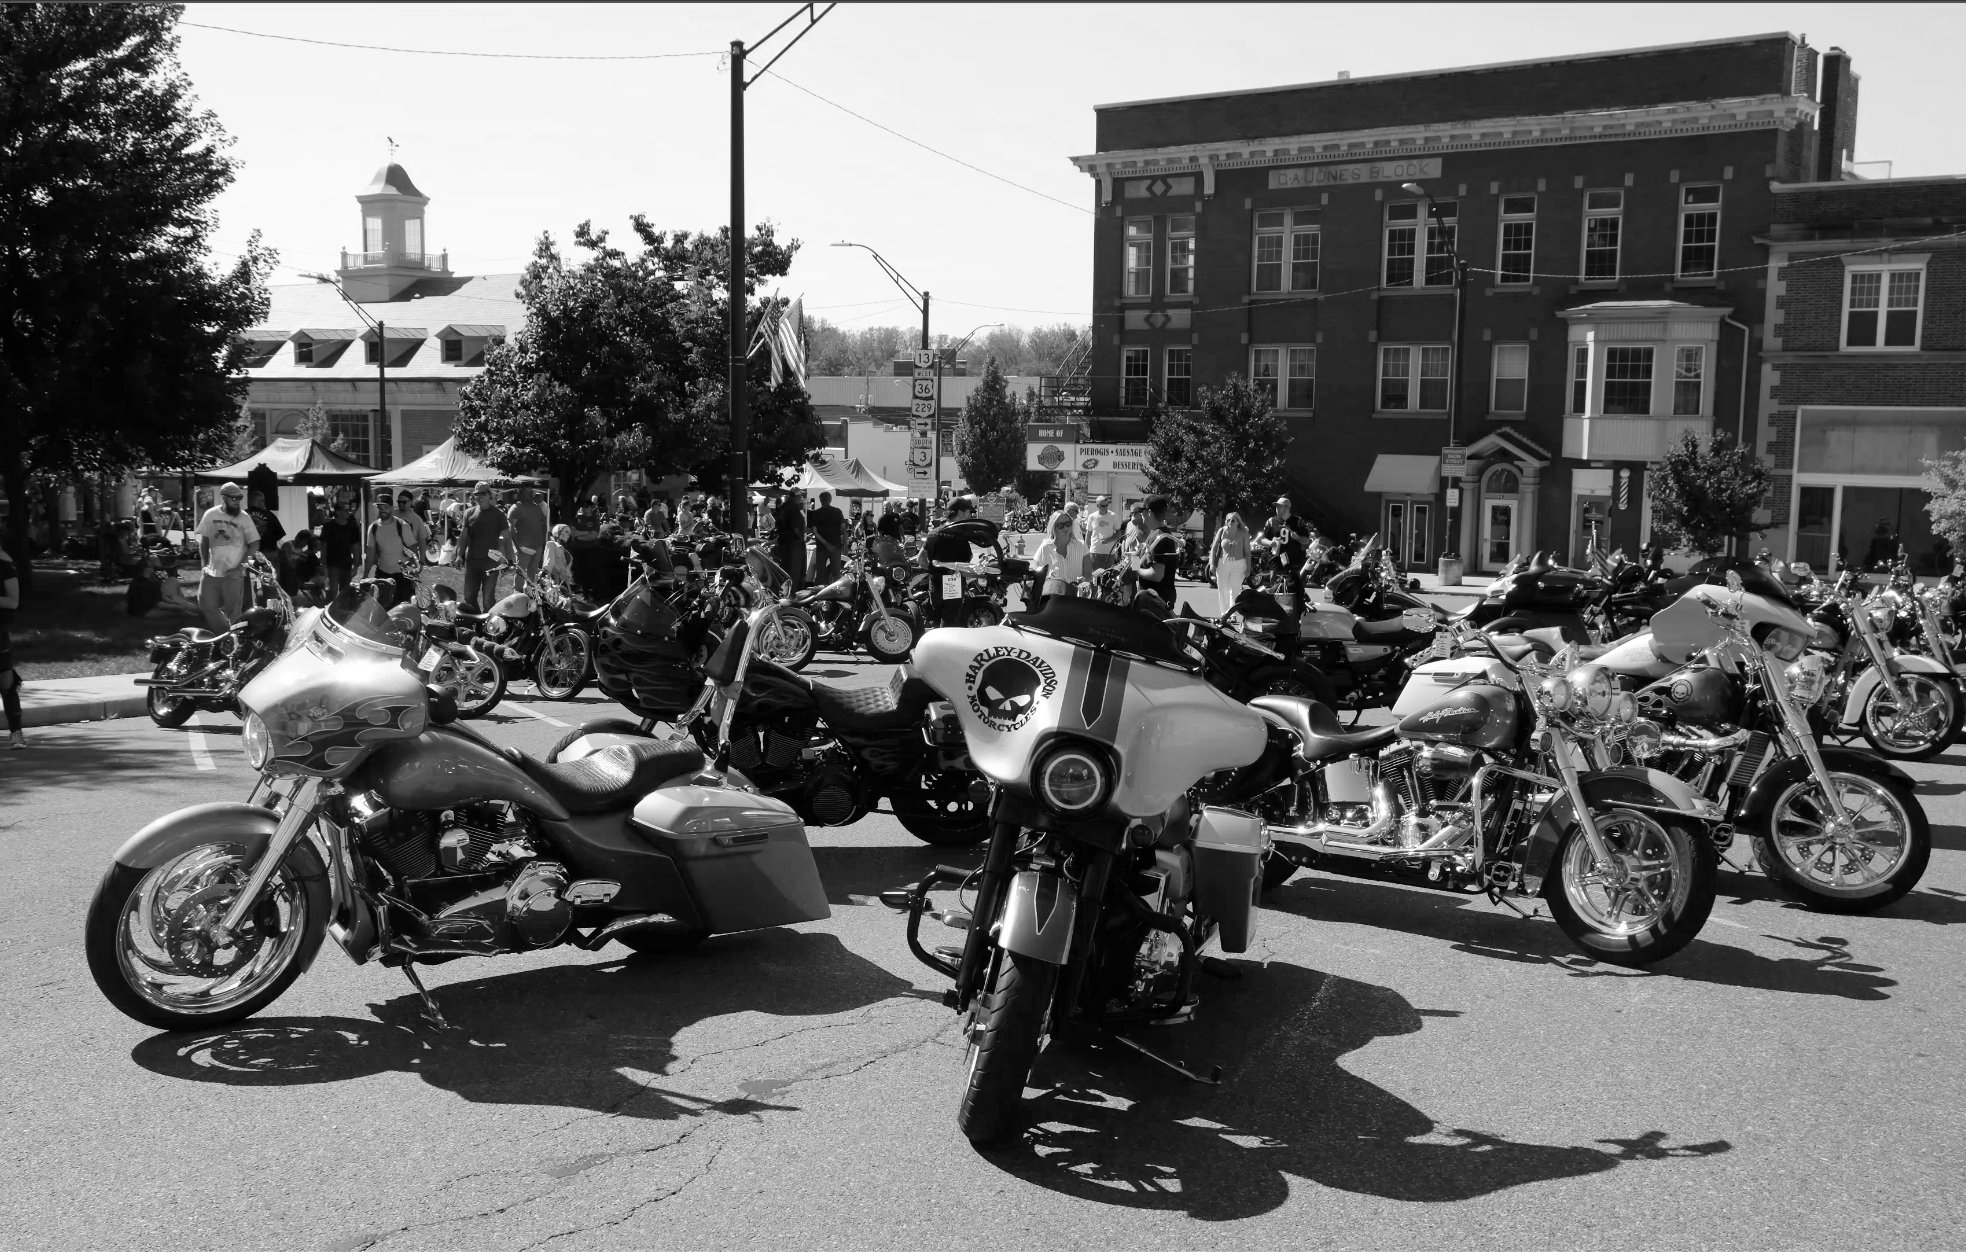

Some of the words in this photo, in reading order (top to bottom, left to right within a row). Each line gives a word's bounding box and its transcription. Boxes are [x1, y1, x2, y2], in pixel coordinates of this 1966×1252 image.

[1369, 161, 1431, 180] BLOCK
[918, 353, 930, 364] 13
[917, 383, 931, 394] 36
[914, 403, 932, 413] 229
[1038, 429, 1055, 438] HOME
[1056, 429, 1064, 438] OF
[919, 451, 927, 462] 3
[1079, 447, 1110, 457] PIEROGIS
[1115, 448, 1143, 458] SAUSAGE
[1279, 527, 1289, 545] 9
[965, 646, 1059, 700] HARLEY-DAVIDSON
[967, 694, 1038, 732] MOTORCYCLES
